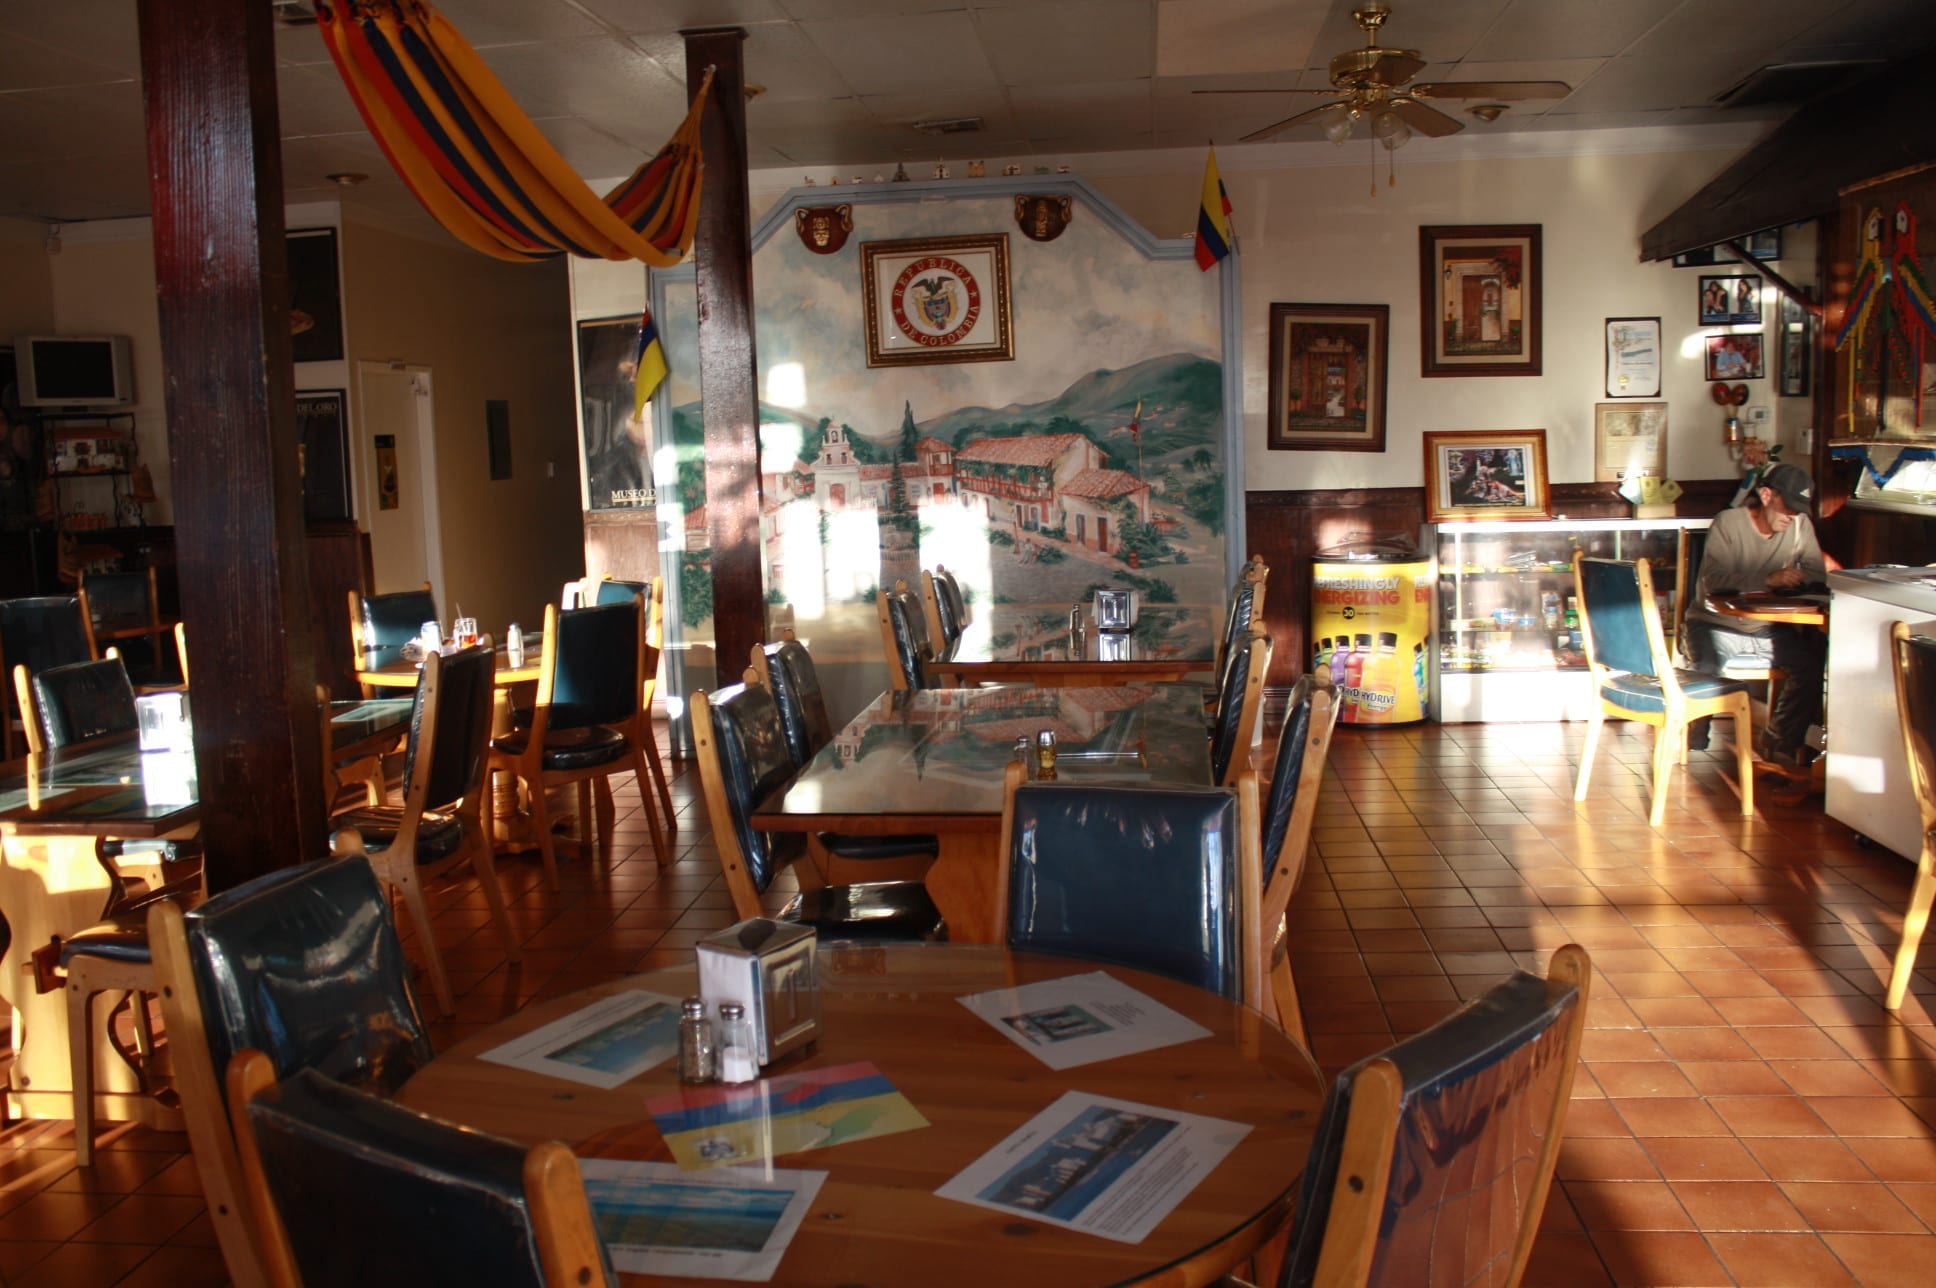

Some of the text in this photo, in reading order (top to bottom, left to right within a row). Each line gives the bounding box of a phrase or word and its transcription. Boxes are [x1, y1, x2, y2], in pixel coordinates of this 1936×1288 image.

[902, 306, 979, 345] DE COLOMBIA
[612, 489, 647, 501] MUSEO
